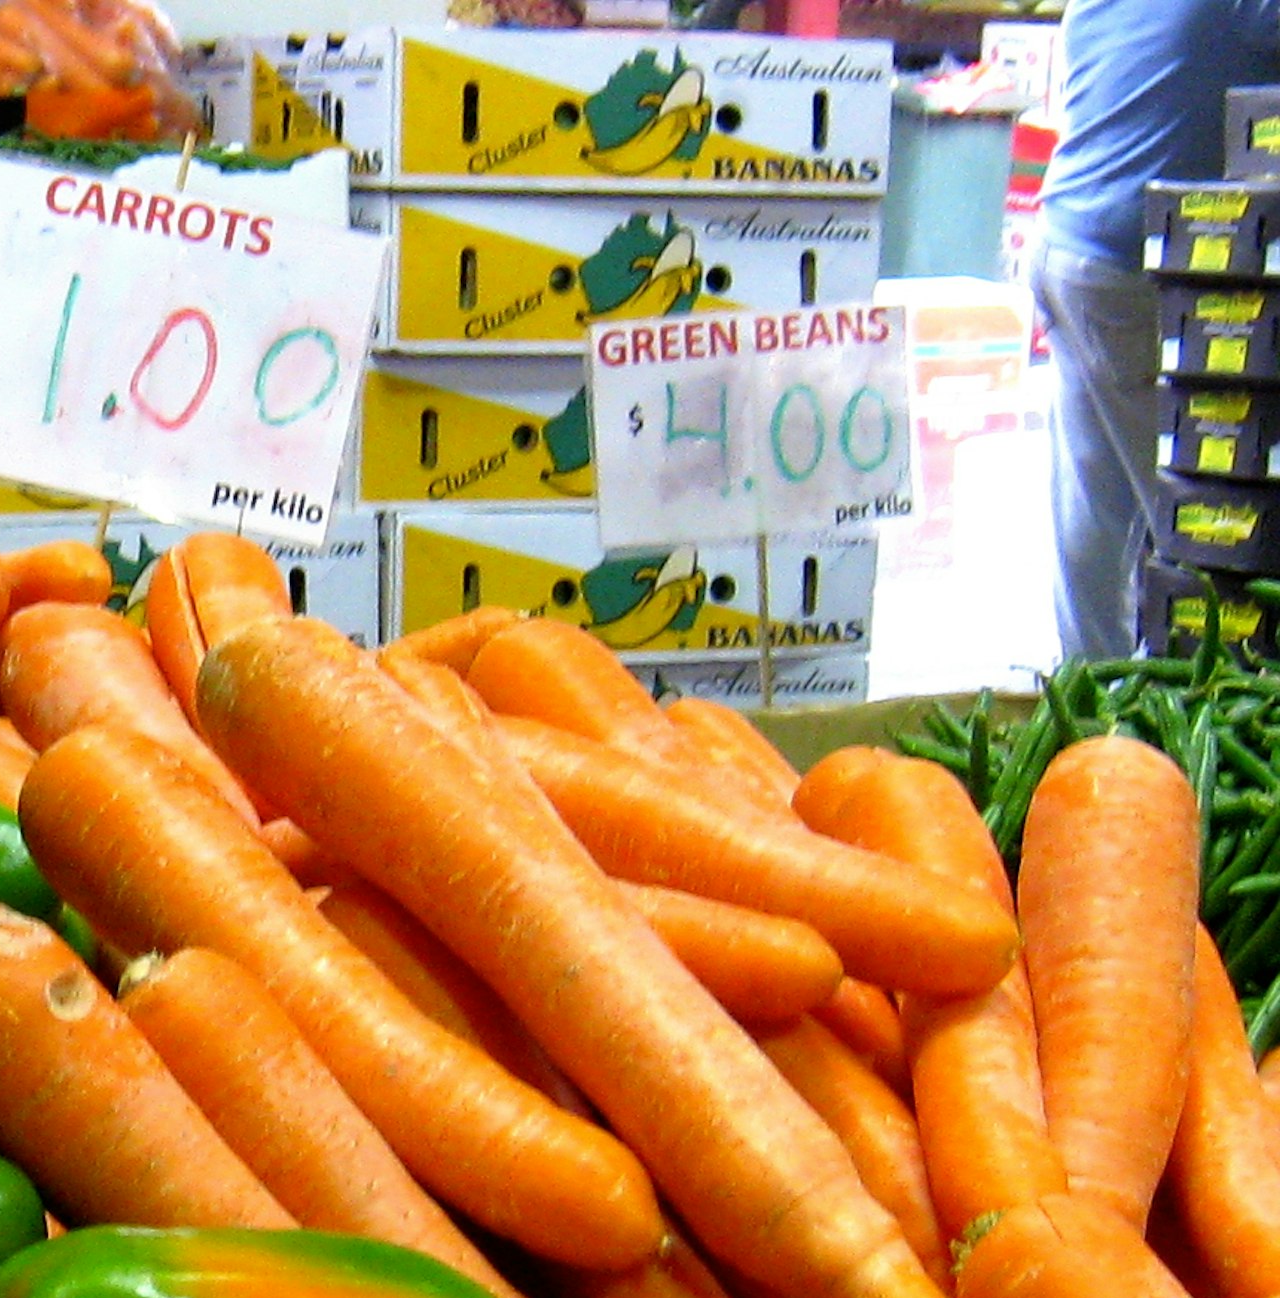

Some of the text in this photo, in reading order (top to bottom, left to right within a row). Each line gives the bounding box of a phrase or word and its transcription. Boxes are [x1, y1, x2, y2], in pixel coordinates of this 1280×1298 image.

[715, 45, 886, 84] Australian
[468, 124, 549, 176] Cluster
[712, 157, 880, 182] BANANAS
[45, 175, 274, 257] CARROTS
[704, 208, 874, 244] Australian
[464, 290, 545, 341] Cluster
[597, 306, 891, 368] GREEN BEANS
[42, 273, 340, 432] 1.00
[627, 382, 895, 500] $ 4.00
[428, 449, 510, 501] Cluster
[211, 481, 325, 525] per kilo
[834, 494, 914, 525] per kilo
[692, 664, 856, 697] Ausralian
